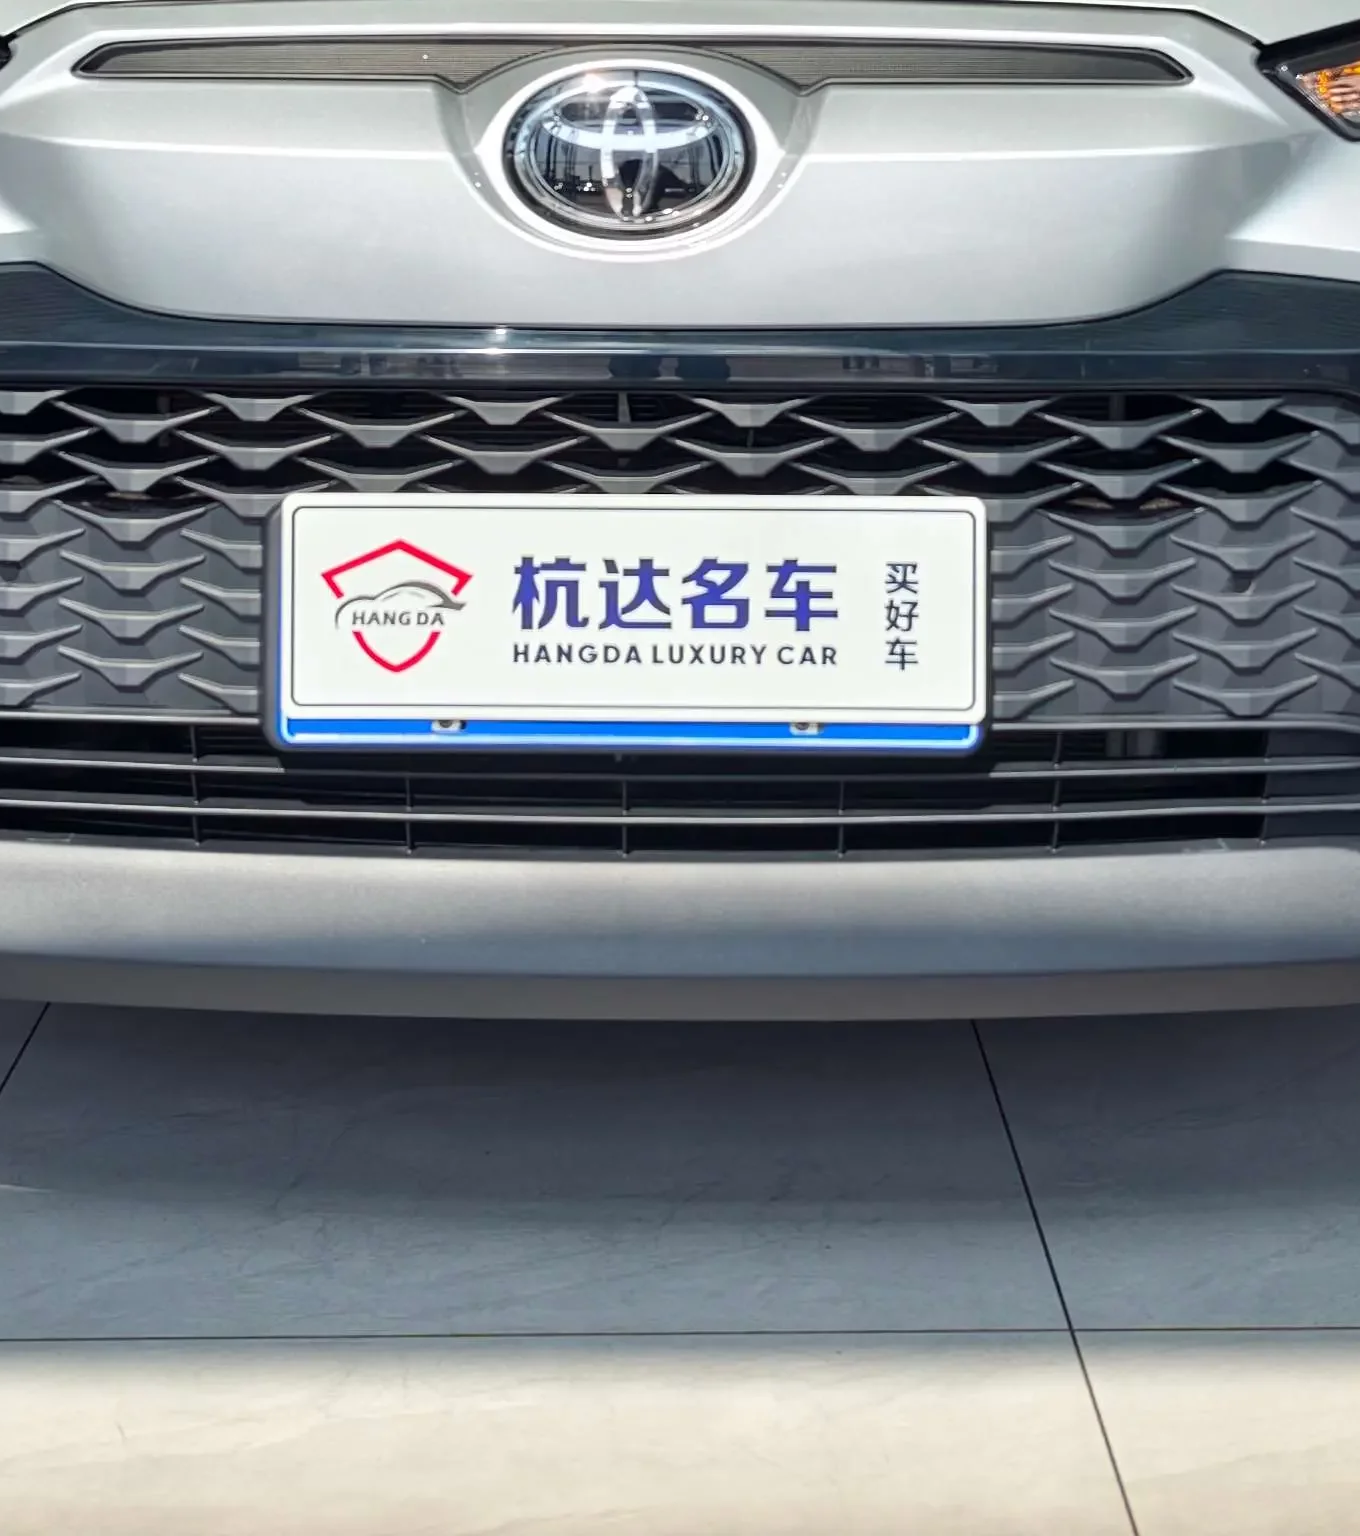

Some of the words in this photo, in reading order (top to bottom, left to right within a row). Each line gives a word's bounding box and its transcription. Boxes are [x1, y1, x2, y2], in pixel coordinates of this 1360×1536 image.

[351, 609, 412, 627] HANG
[414, 610, 446, 627] DA
[511, 556, 839, 633] 杭达名车
[883, 561, 920, 672] 买好车
[512, 643, 643, 665] HANGDA
[651, 644, 768, 666] LUXURY
[776, 645, 839, 666] CAR
